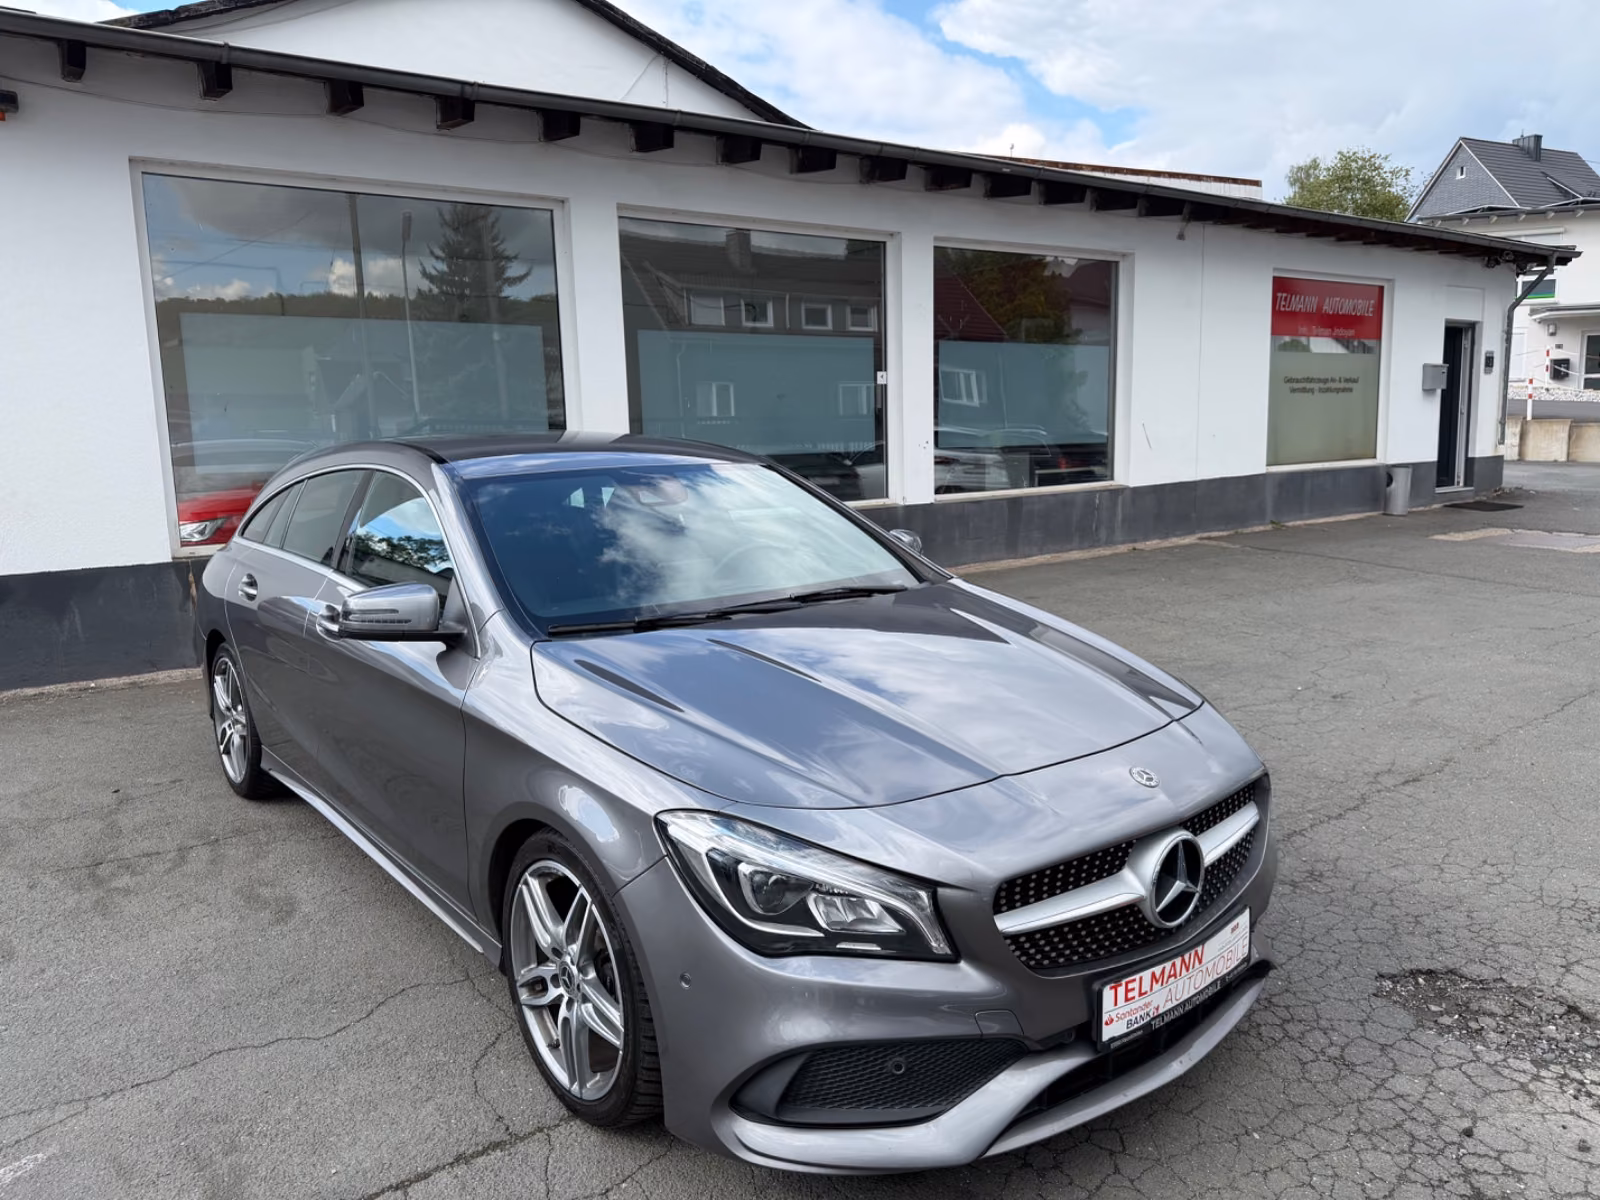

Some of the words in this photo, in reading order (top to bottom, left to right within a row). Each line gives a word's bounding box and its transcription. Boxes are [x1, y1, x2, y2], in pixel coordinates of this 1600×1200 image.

[1276, 292, 1318, 313] TELMANN
[1322, 297, 1375, 316] AUTOMOBILE
[1109, 944, 1205, 1007] TELMANN
[1162, 935, 1248, 1008] AUTOMOBILE
[1115, 1000, 1153, 1022] Santander
[1126, 1008, 1151, 1030] BANK
